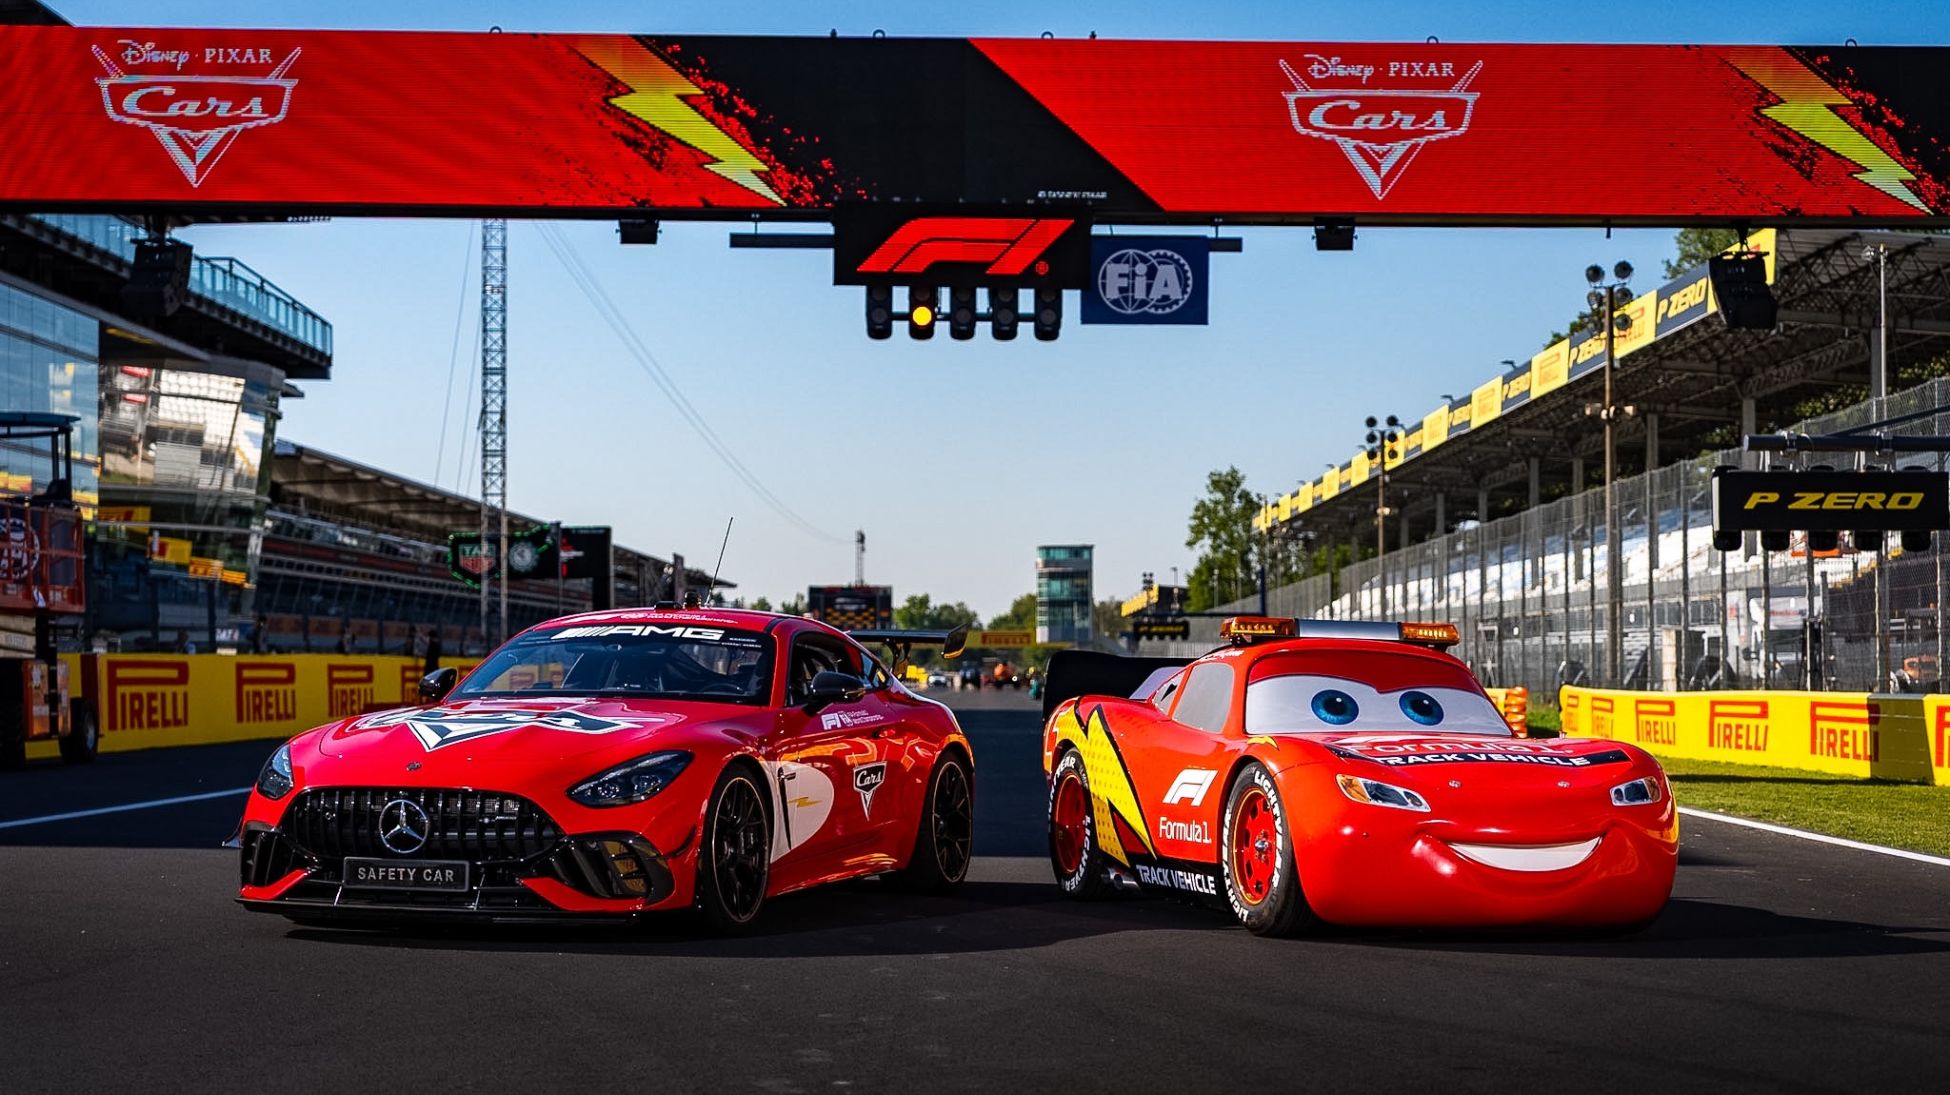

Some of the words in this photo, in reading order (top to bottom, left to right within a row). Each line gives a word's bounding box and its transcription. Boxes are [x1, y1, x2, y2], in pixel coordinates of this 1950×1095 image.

[204, 48, 273, 63] PIXAR
[1388, 62, 1455, 77] PIXAR
[122, 86, 269, 117] Cars
[1308, 100, 1452, 130] Cars
[1657, 297, 1668, 323] P
[1667, 278, 1708, 319] ZERO
[1744, 492, 1780, 509] P
[1787, 492, 1924, 509] ZERO
[107, 660, 189, 731] PIRELLI
[236, 662, 296, 724] PIRELLI
[1635, 700, 1676, 745] PIRELLI
[1709, 701, 1768, 752] PIRELLI
[1810, 701, 1880, 762] PIRELLI
[1374, 753, 1465, 765] TRACK
[1467, 753, 1591, 766] VEHICLE
[856, 770, 883, 787] Cars
[358, 867, 417, 881] SAFETY
[423, 869, 454, 882] CAR
[1135, 864, 1172, 888] TRACK
[1170, 869, 1217, 895] VEHICLE
